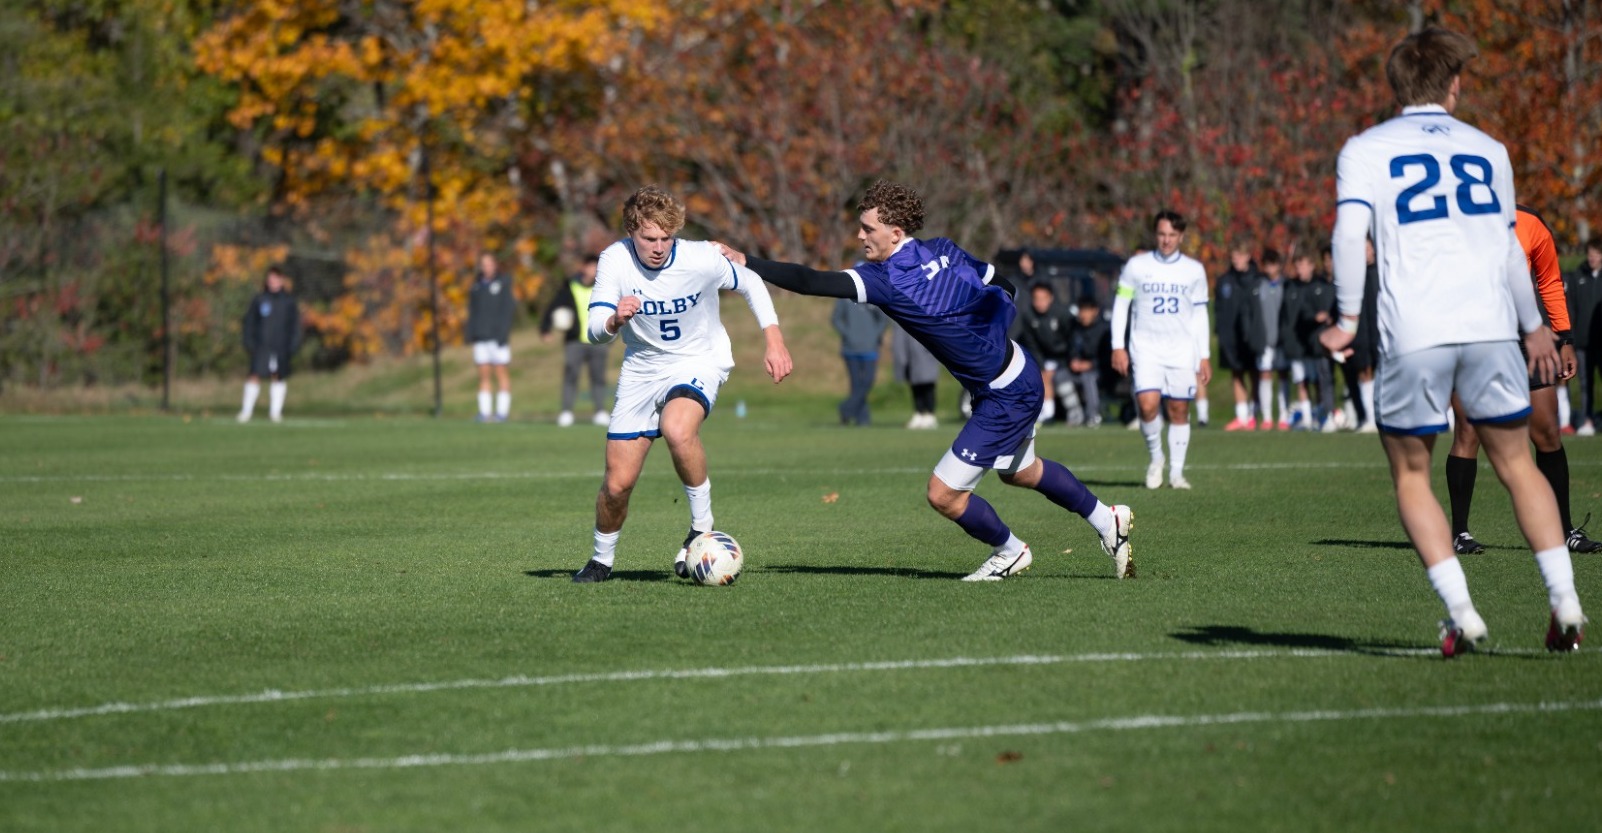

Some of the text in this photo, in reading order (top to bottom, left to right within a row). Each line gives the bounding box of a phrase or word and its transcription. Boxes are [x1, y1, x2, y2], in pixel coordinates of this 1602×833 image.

[1389, 153, 1502, 225] 28
[1142, 282, 1188, 295] COLBY
[636, 291, 702, 316] OLBY
[1153, 296, 1179, 313] 23
[660, 319, 682, 341] 5
